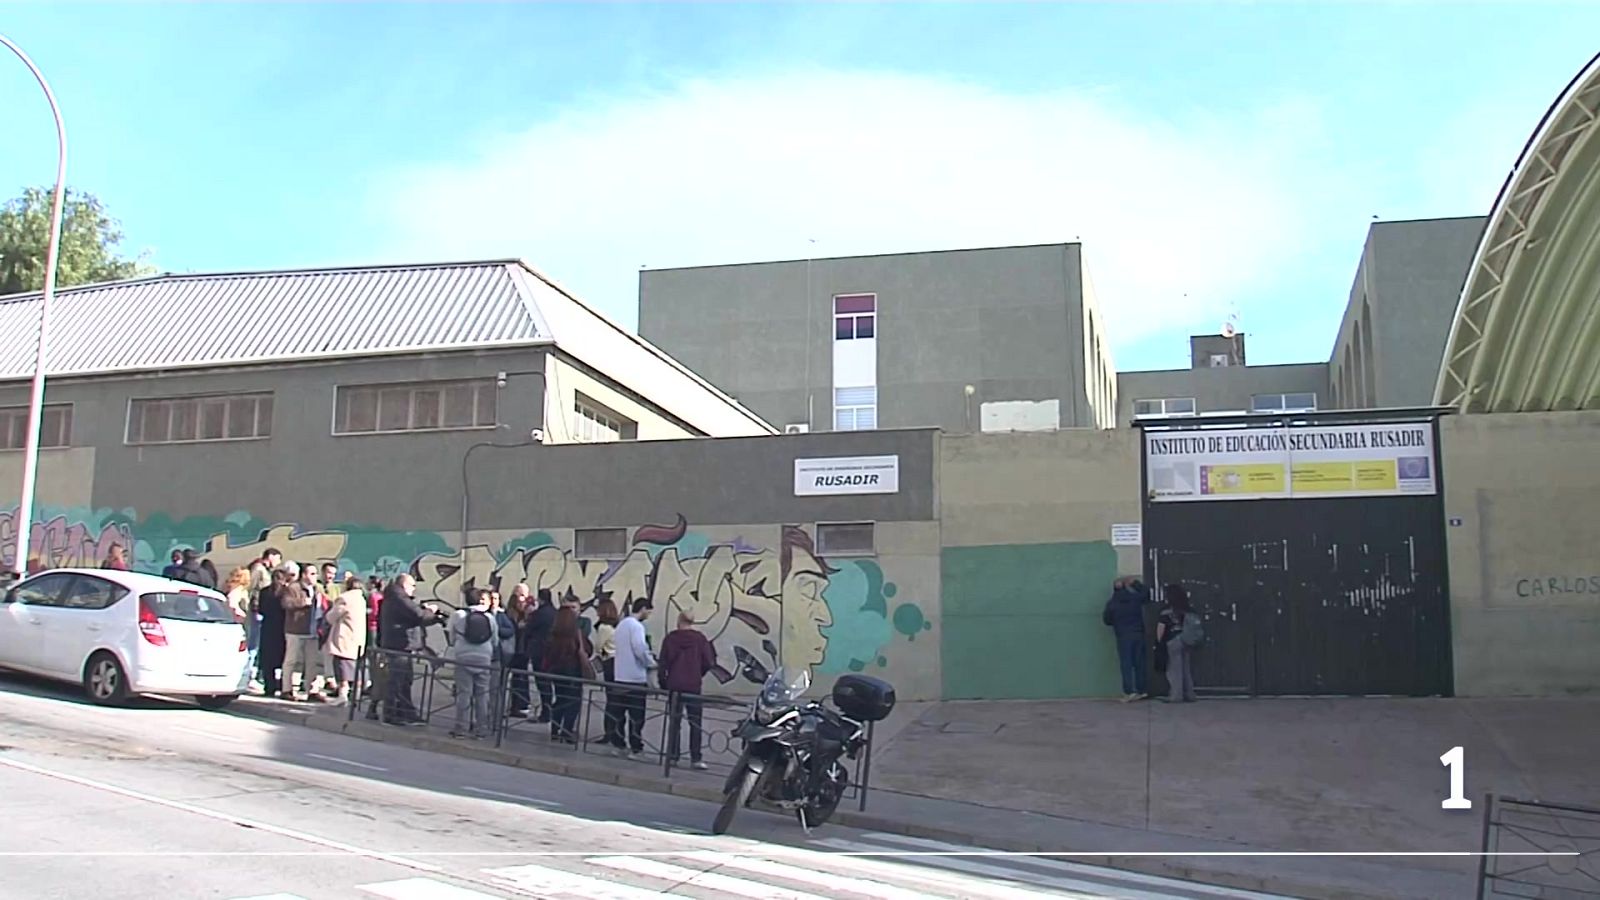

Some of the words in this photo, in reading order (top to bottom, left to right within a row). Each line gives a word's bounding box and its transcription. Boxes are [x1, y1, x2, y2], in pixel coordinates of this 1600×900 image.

[1150, 437, 1206, 455] INSTITUTO
[1208, 436, 1224, 453] DE
[1225, 430, 1287, 452] EDUCACIÓN
[1289, 431, 1367, 450] SECUNDARIA
[1370, 429, 1425, 448] RUSADIR
[814, 474, 879, 487] RUSADIR
